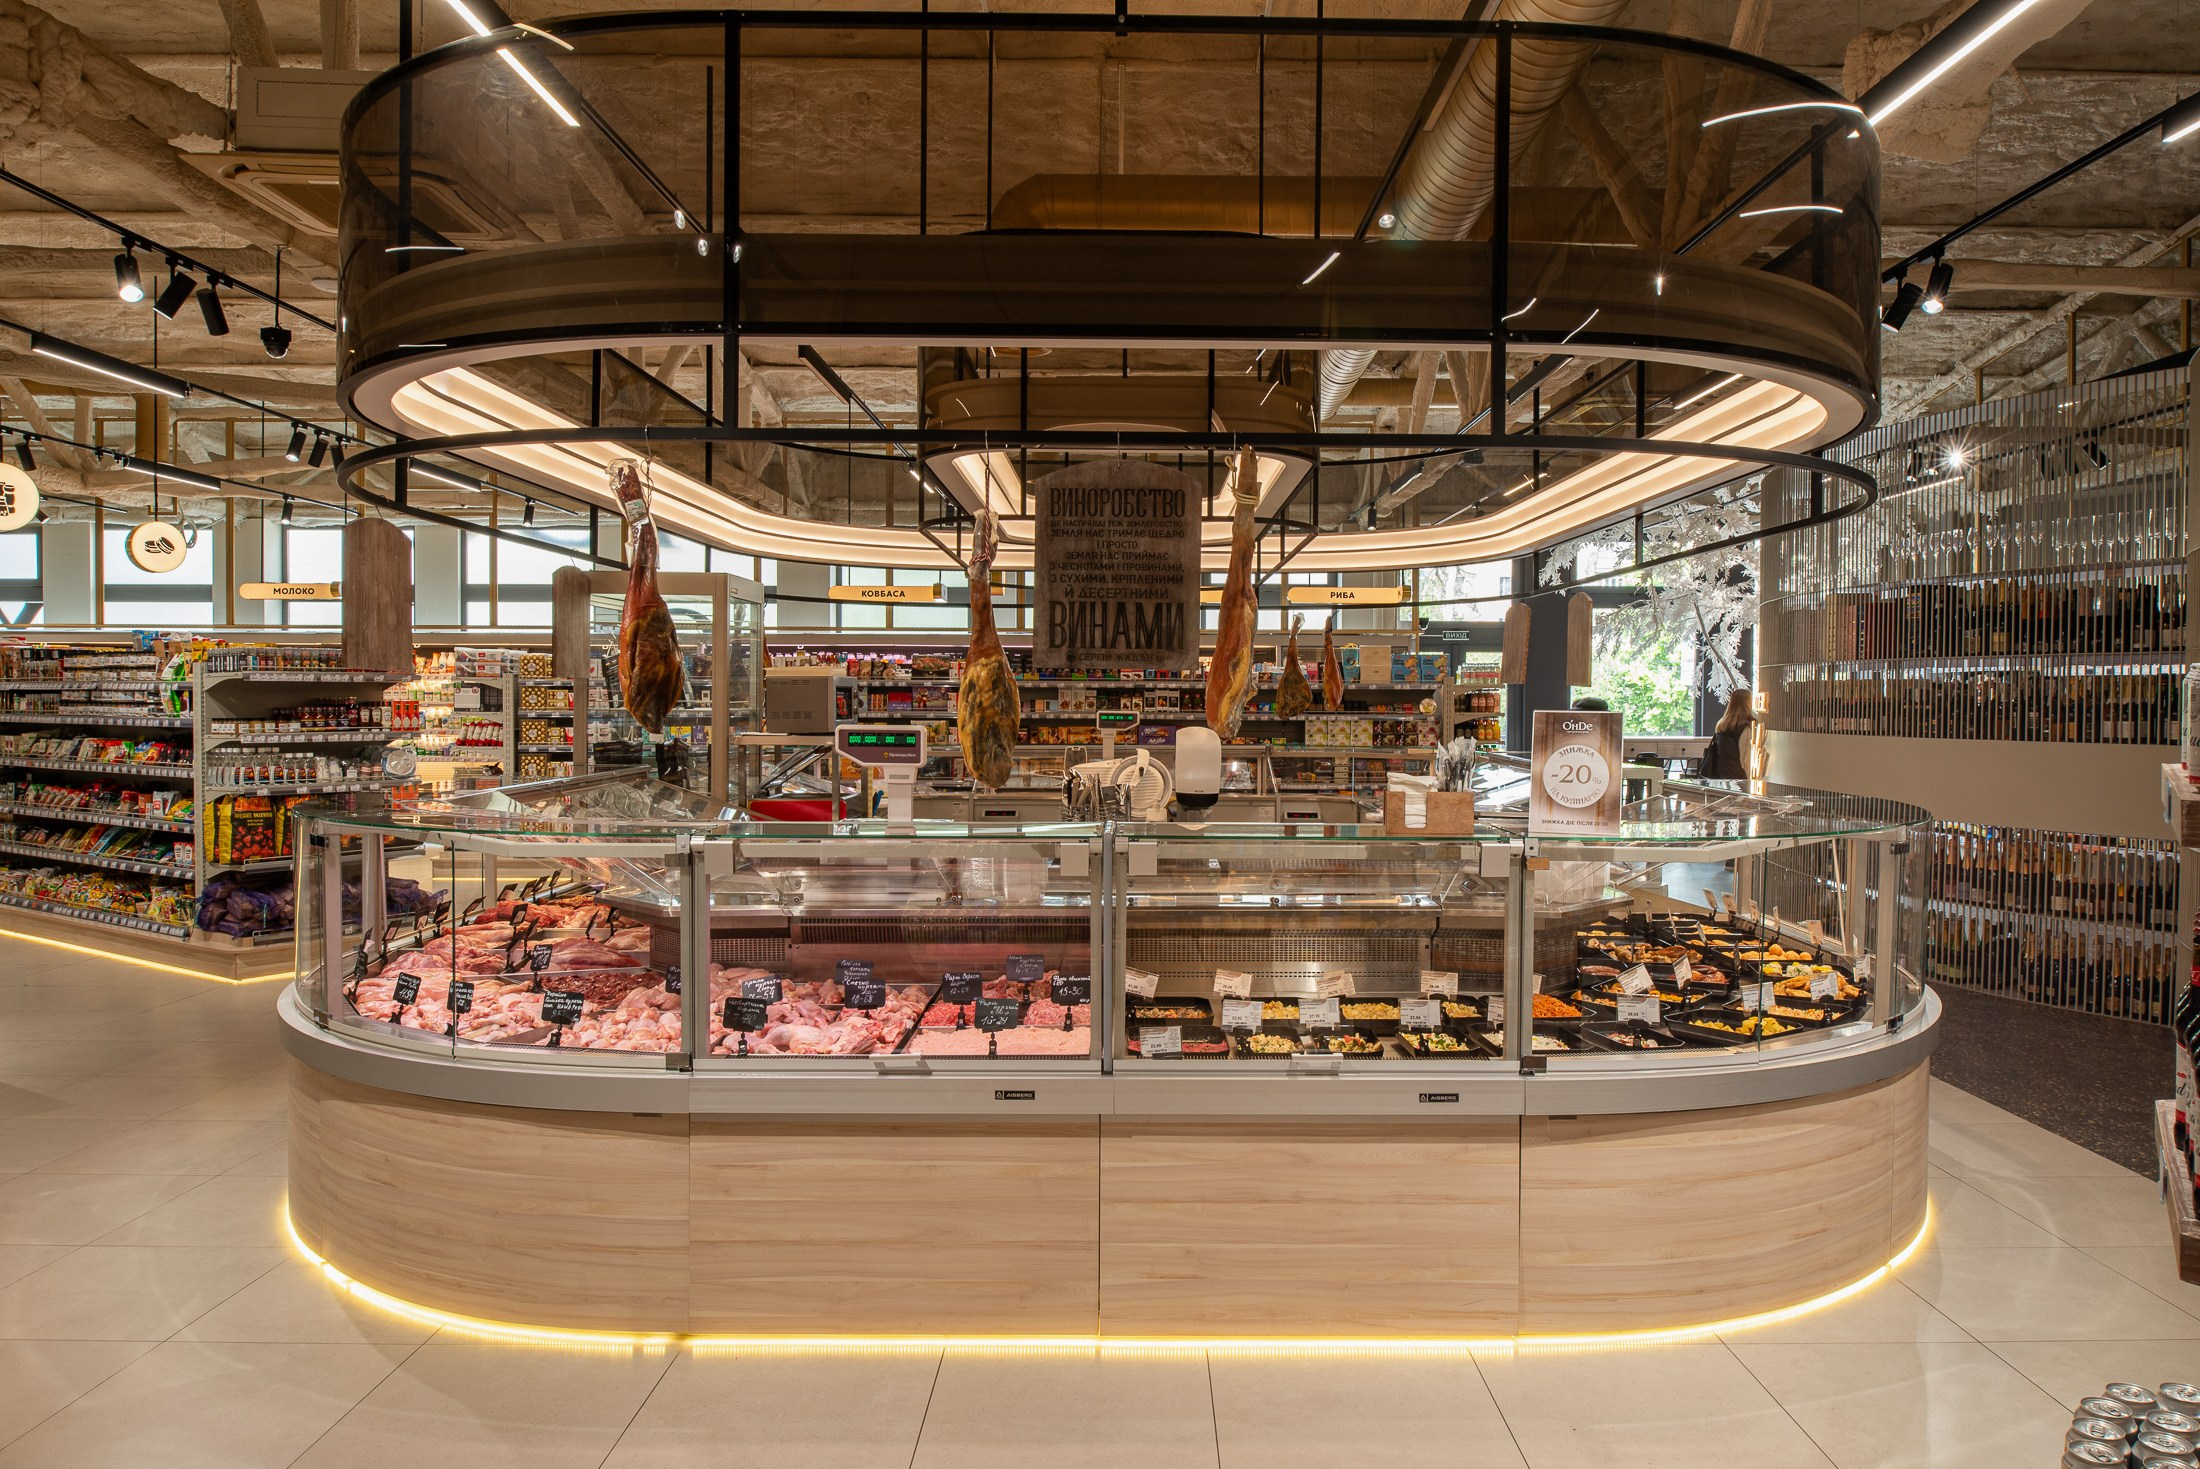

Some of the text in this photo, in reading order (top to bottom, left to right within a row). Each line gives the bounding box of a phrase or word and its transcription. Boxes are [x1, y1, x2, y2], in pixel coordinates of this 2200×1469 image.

[1049, 487, 1186, 518] ВИНОРОБСТВО
[1051, 520, 1060, 528] ЦЕ
[1063, 520, 1106, 528] НАСПРАВДІ
[1108, 520, 1124, 528] ТЕЖ
[1051, 529, 1185, 540] ЗЕМЛЯ НАС ТРИМАЄ ЩЕДРО
[1102, 541, 1140, 549] ПРОСТО.
[1066, 550, 1169, 561] ЗЕМЛЯ НАС ПРИЙМАЄ
[1050, 563, 1056, 571] З
[1058, 562, 1115, 571] ЧЕСНОТАМИ
[1122, 563, 1185, 573] ПРОВИНАМИ,
[1051, 574, 1057, 583] З
[1111, 574, 1184, 585] КРІПЛЕНИМИ
[273, 587, 315, 595] МОЛОКО
[861, 590, 906, 598] КОВБАСА
[1064, 584, 1169, 599] Й ДЕСЕРТНИМИ
[1330, 591, 1355, 599] РИБА
[1048, 600, 1185, 650] ВИНАМИ
[1080, 651, 1153, 661] СЕРГІЙ ЖАДАН
[1558, 746, 1595, 758] ЗНИЖКА
[1550, 787, 1560, 798] НА
